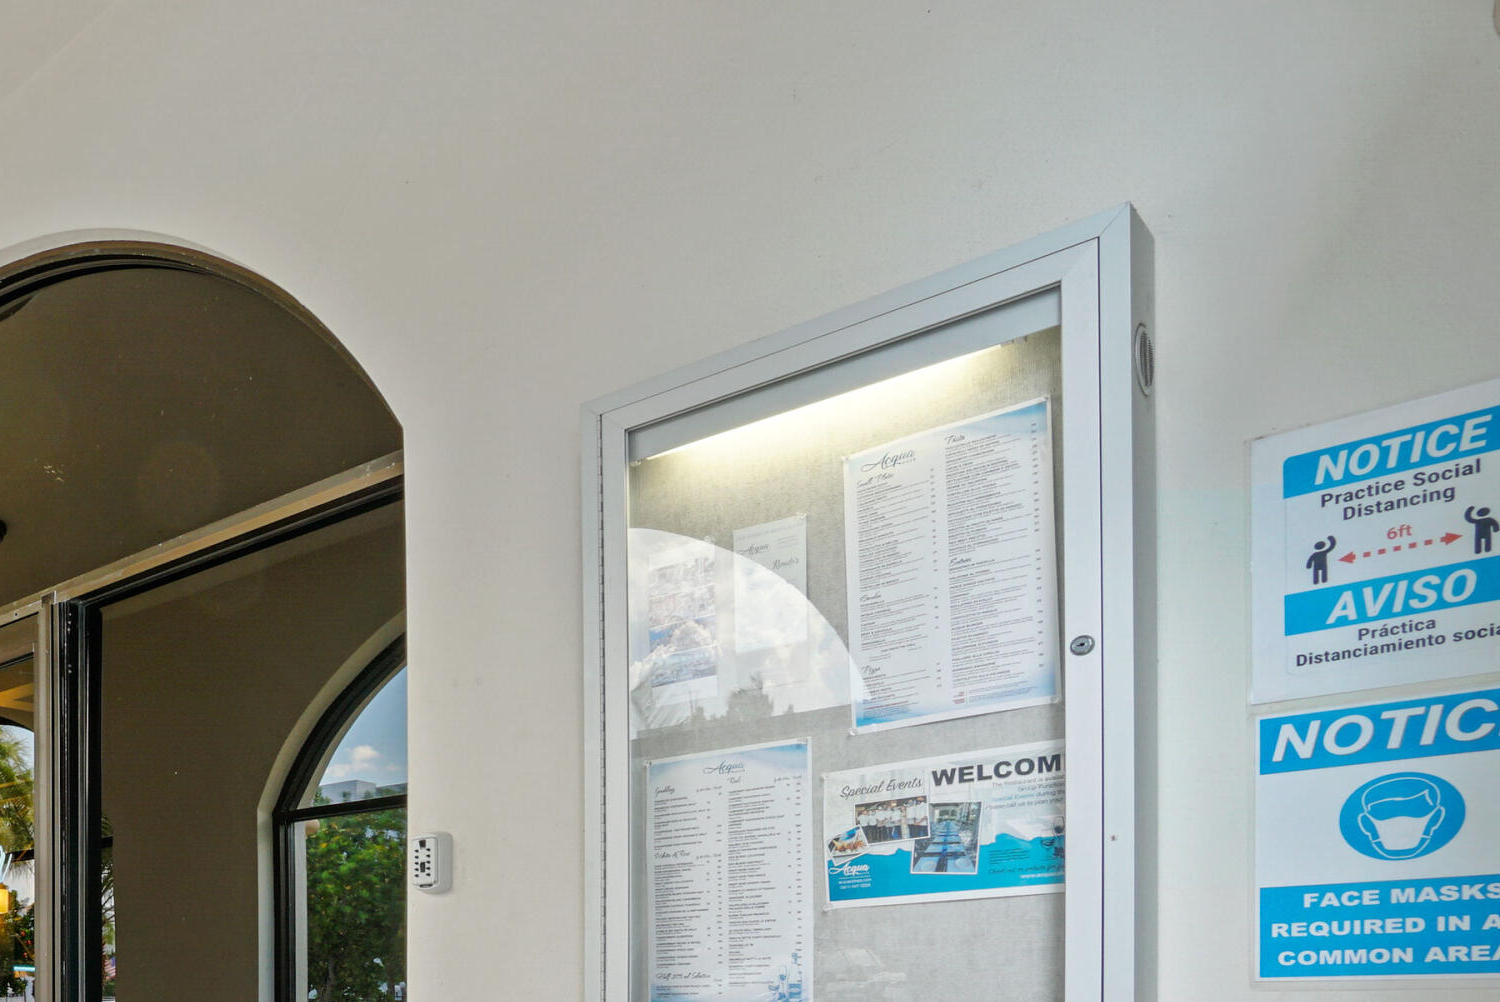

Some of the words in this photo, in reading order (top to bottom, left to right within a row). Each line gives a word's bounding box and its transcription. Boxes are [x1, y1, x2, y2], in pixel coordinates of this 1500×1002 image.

[861, 449, 916, 472] Acqua
[1314, 414, 1493, 486] NOTICE
[1320, 479, 1405, 508] Practice
[1412, 458, 1482, 487] Social
[1342, 486, 1456, 521] Distancing
[1386, 524, 1413, 540] 6ft
[1325, 568, 1478, 625] AVISO
[1358, 619, 1437, 641] Práctica
[1296, 634, 1446, 667] Distanciamiento
[1272, 699, 1500, 763] NOTIC
[839, 780, 885, 800] Special
[886, 777, 922, 792] Events
[828, 861, 870, 876] Acqua
[1303, 889, 1381, 908] FACE
[1390, 882, 1500, 904] MASKS
[1271, 917, 1426, 938] REQUIRED
[1436, 915, 1471, 932] IN
[1277, 947, 1413, 966] COMMON
